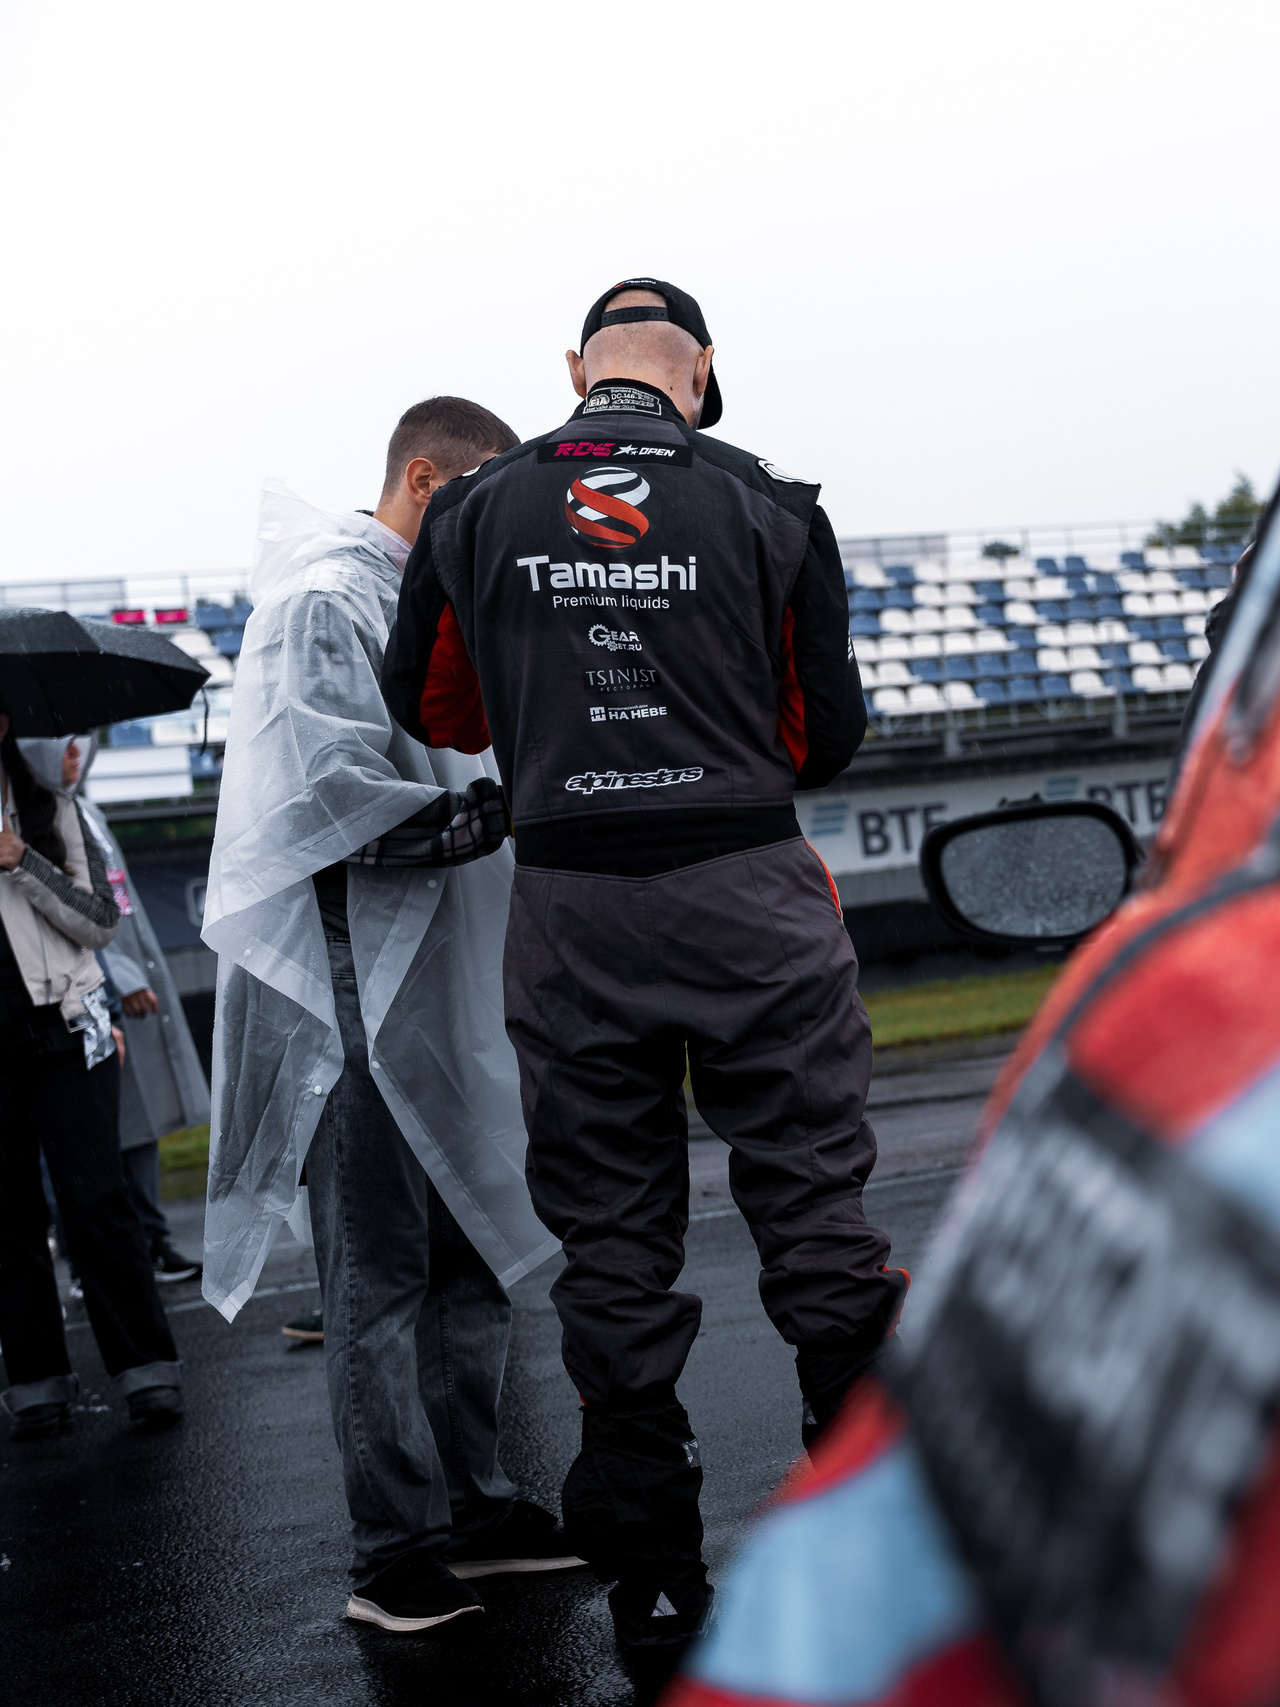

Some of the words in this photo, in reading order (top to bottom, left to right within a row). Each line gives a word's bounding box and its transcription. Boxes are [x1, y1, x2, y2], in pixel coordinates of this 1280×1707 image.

[589, 396, 607, 408] FIA
[554, 442, 616, 457] RDS
[639, 447, 676, 457] OPEN
[516, 555, 697, 591] Tamashi
[553, 594, 617, 608] Premium
[621, 595, 670, 610] liquids
[585, 668, 656, 685] TSINIST
[608, 711, 629, 720] НА
[630, 706, 668, 719] НЕВЕ
[565, 767, 704, 794] alpinestars
